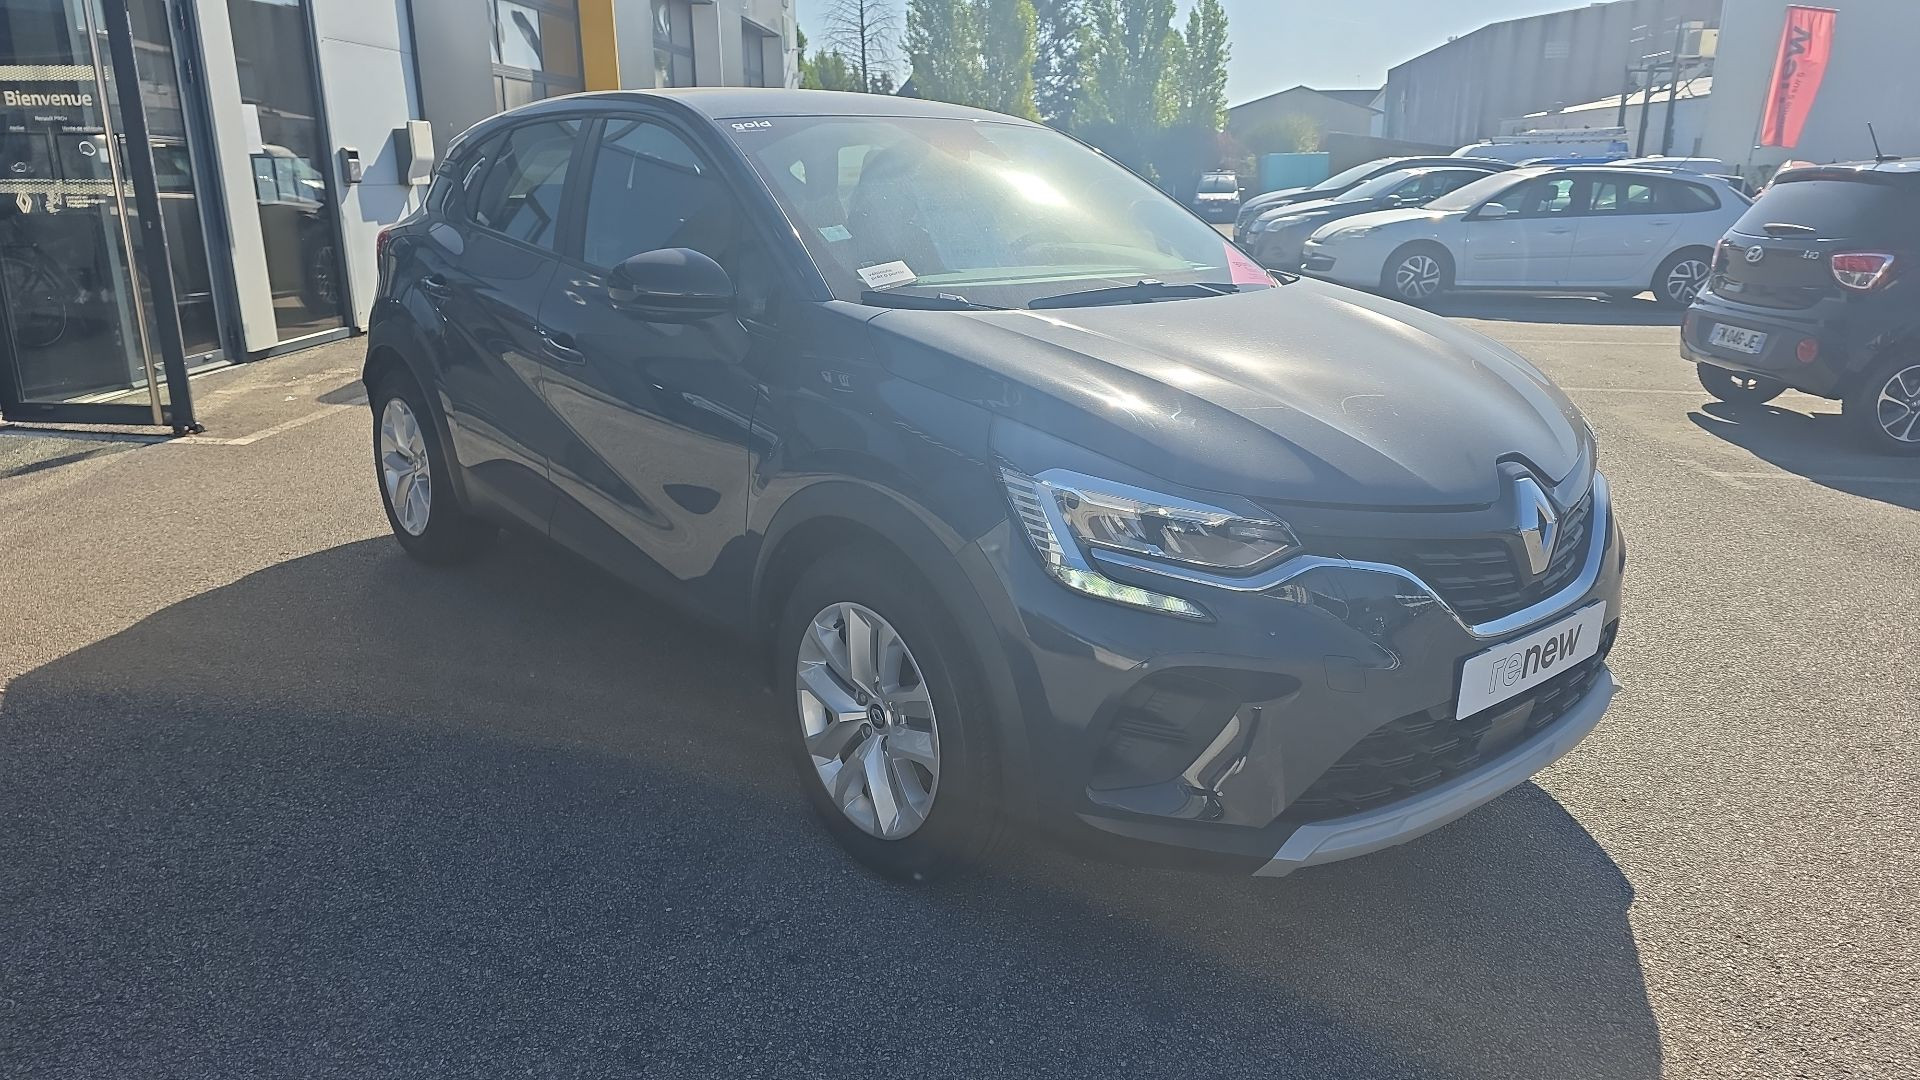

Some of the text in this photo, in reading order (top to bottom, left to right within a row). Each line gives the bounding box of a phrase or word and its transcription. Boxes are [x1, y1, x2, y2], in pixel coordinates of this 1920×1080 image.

[3, 90, 93, 106] Bienvenue
[731, 120, 772, 130] gold
[1488, 623, 1583, 695] renew
